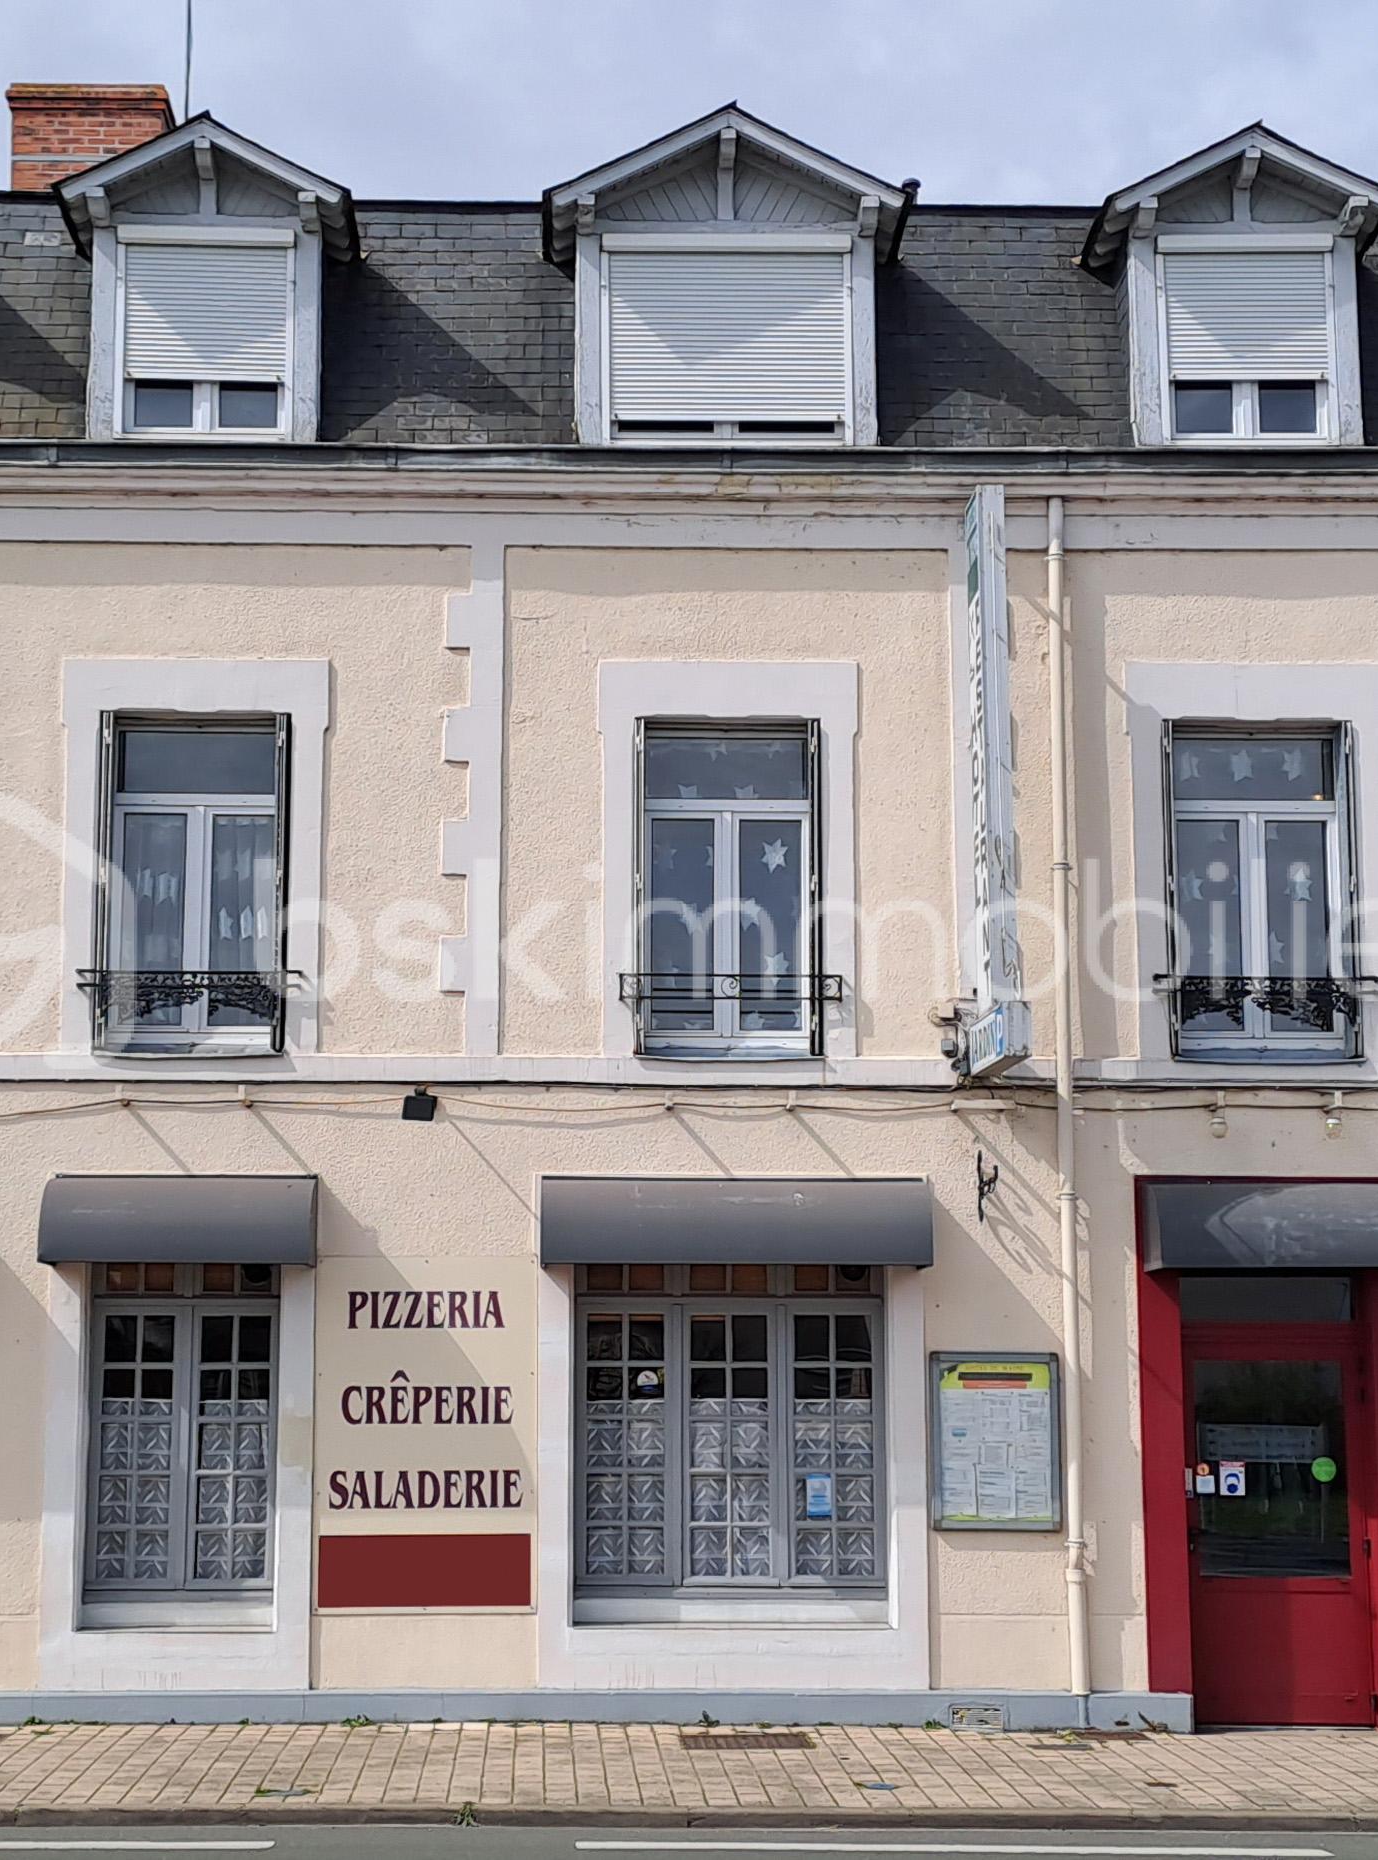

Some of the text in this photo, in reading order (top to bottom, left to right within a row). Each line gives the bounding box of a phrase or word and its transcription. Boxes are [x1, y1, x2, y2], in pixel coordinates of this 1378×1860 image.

[347, 1291, 505, 1329] PIZZERIA
[341, 1370, 514, 1424] CRÊPERIE
[328, 1470, 524, 1510] SALADERIE
